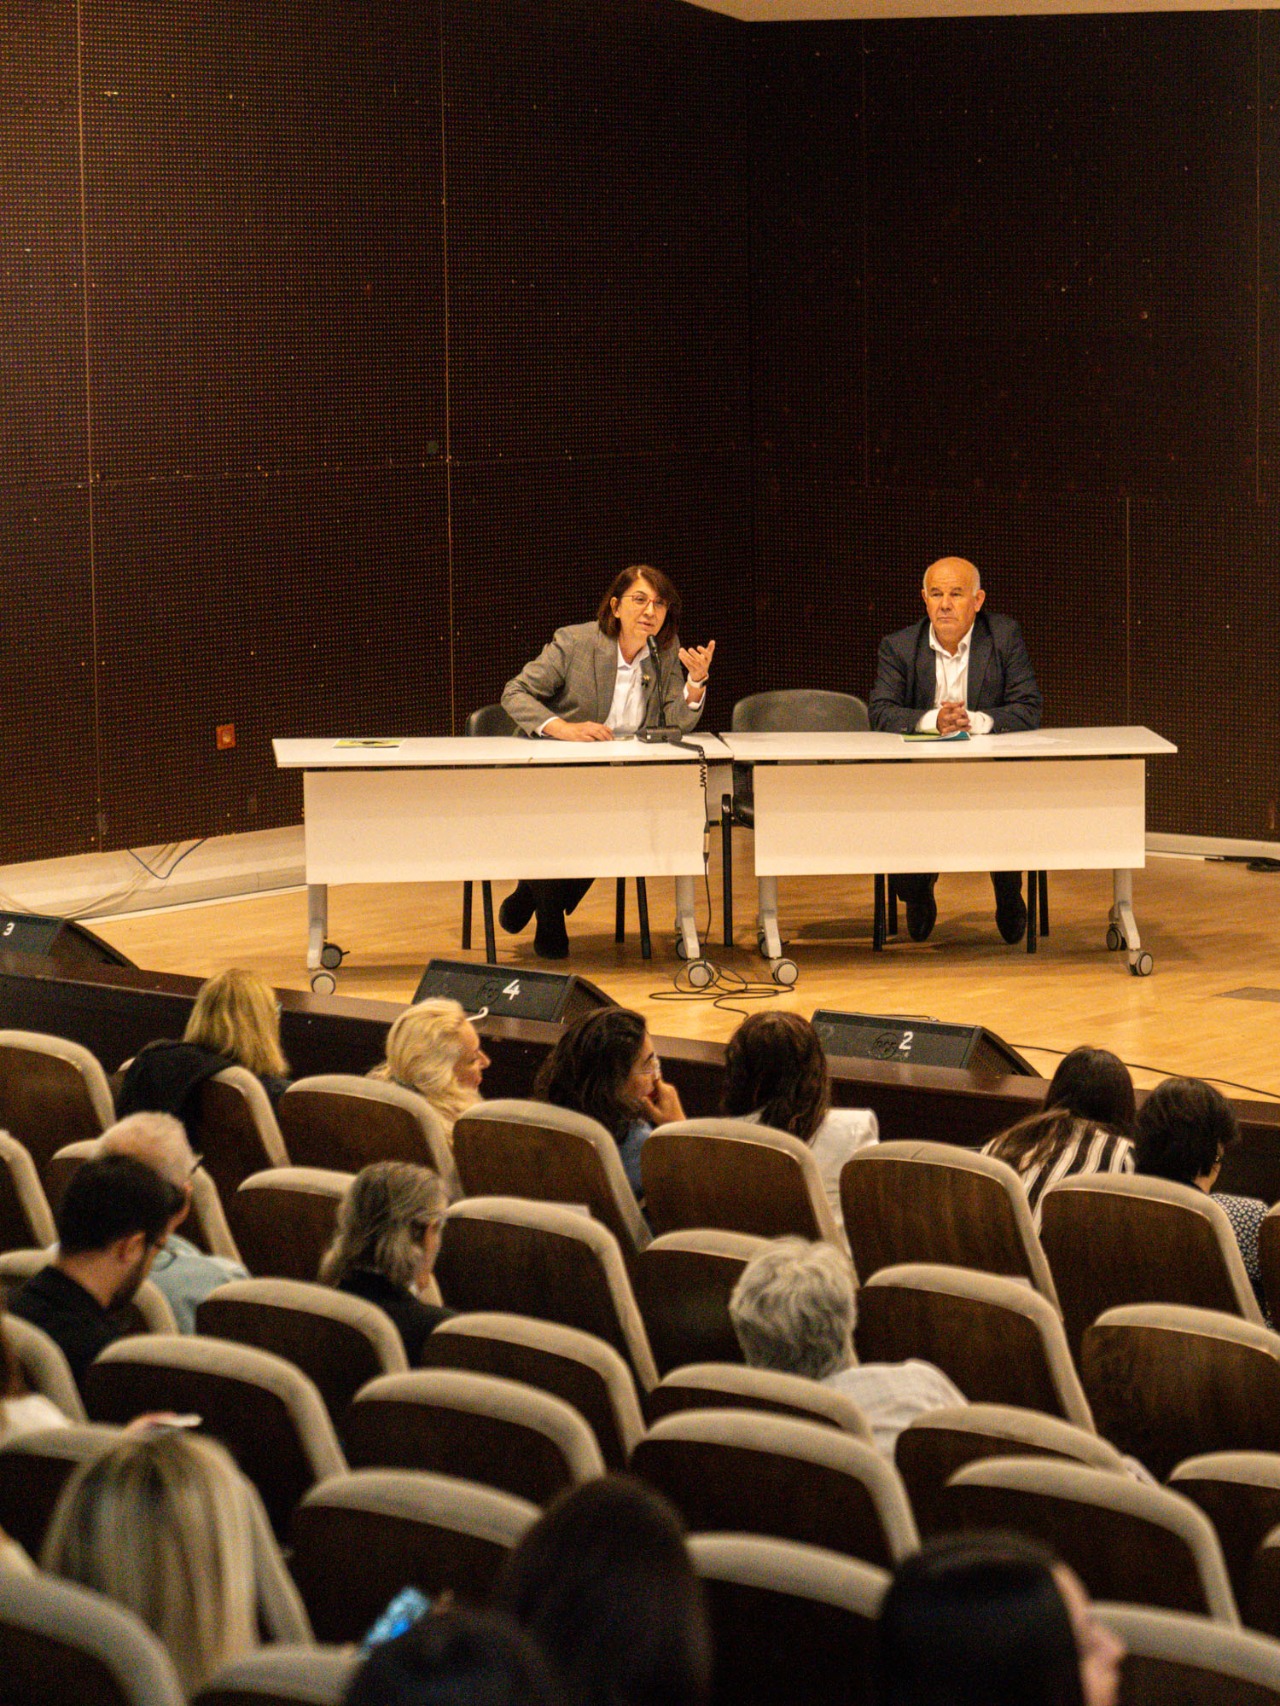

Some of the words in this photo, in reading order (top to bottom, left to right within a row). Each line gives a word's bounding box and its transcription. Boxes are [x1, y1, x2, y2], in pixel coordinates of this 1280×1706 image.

[3, 922, 15, 936] 3
[502, 979, 520, 1000] 4
[899, 1031, 914, 1050] 2
